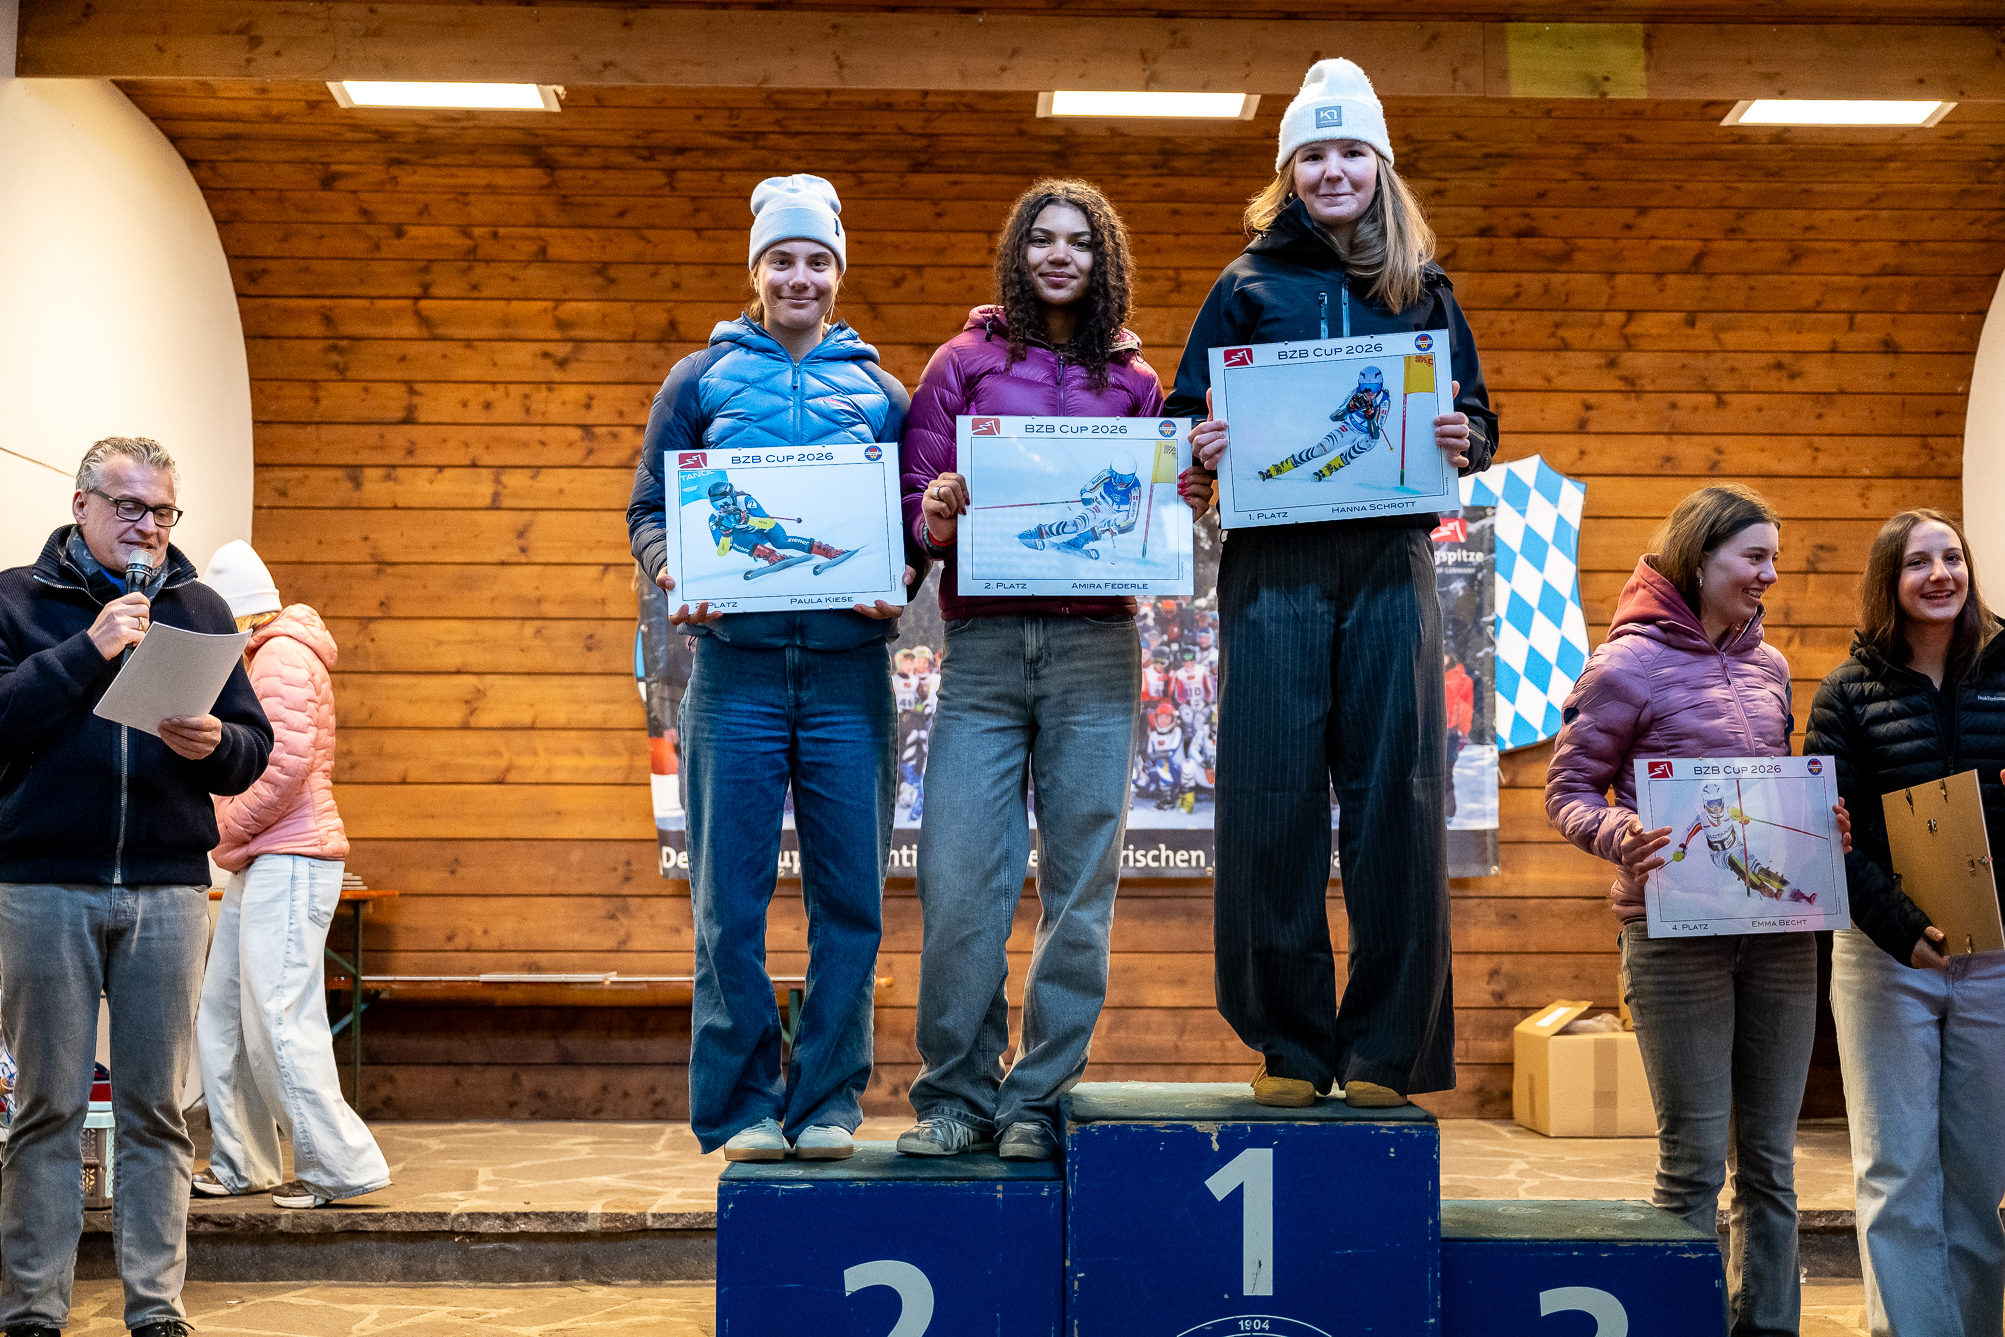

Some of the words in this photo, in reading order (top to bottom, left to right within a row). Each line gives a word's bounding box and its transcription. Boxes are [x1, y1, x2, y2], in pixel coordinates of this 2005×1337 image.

[1278, 349, 1309, 360] BZB
[1346, 343, 1383, 355] 2026
[1025, 424, 1056, 434] BZB
[1092, 425, 1128, 434] 2026
[732, 455, 762, 465] BZB
[797, 452, 834, 462] 2026
[1248, 513, 1255, 521] 1.
[1433, 548, 1485, 566] gspitze
[985, 582, 994, 590] 2.
[1694, 766, 1720, 775] BZB
[1751, 764, 1782, 774] 2026
[1120, 843, 1206, 868] rischen
[1204, 1148, 1273, 1295] 1
[1238, 1319, 1270, 1331] 1904
